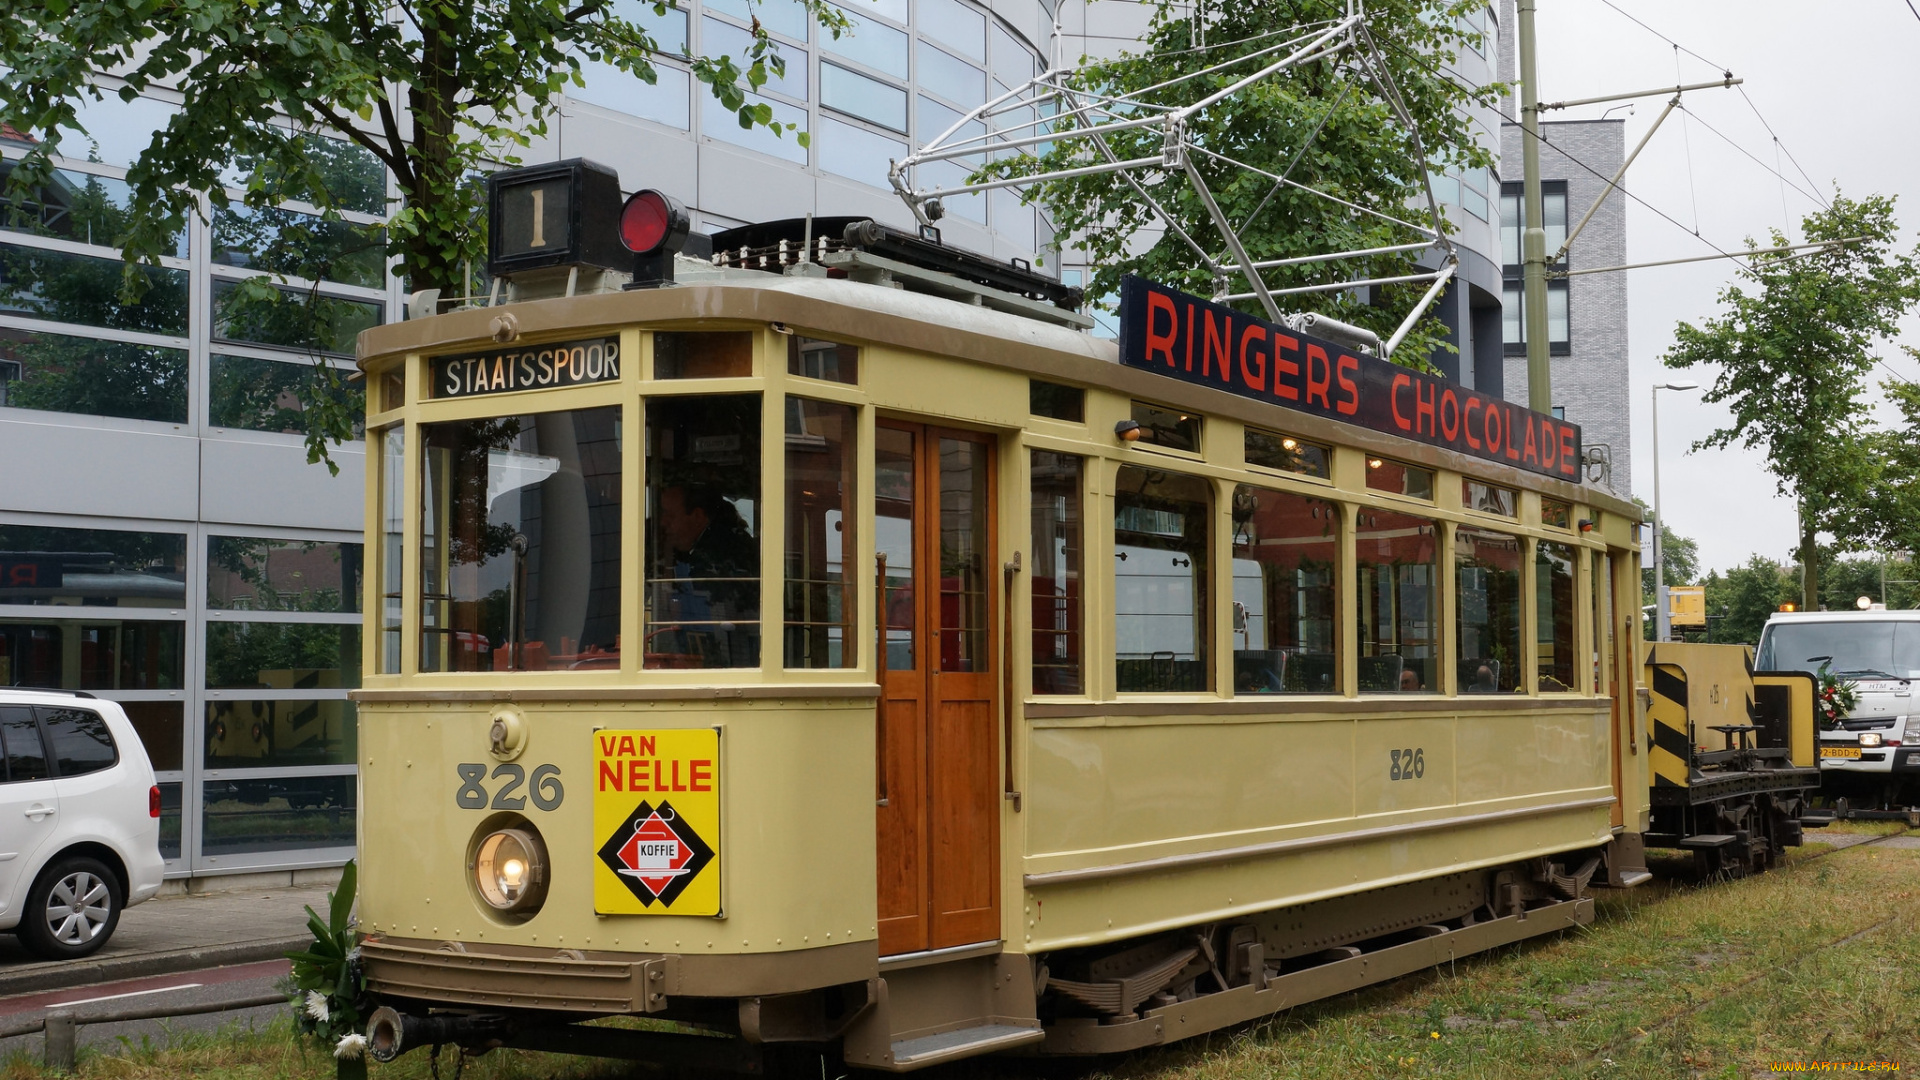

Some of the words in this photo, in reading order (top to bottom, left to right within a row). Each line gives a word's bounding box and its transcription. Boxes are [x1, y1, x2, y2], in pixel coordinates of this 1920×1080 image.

[530, 189, 547, 248] 1
[446, 342, 619, 395] STAATSSPOOR
[1145, 290, 1359, 416] RINGERS
[1391, 373, 1576, 476] CHOCOLADE
[600, 736, 656, 757] VAN
[1390, 748, 1425, 780] 826
[456, 763, 564, 811] 826
[600, 760, 712, 792] NELLE
[640, 844, 675, 857] KOFFIE
